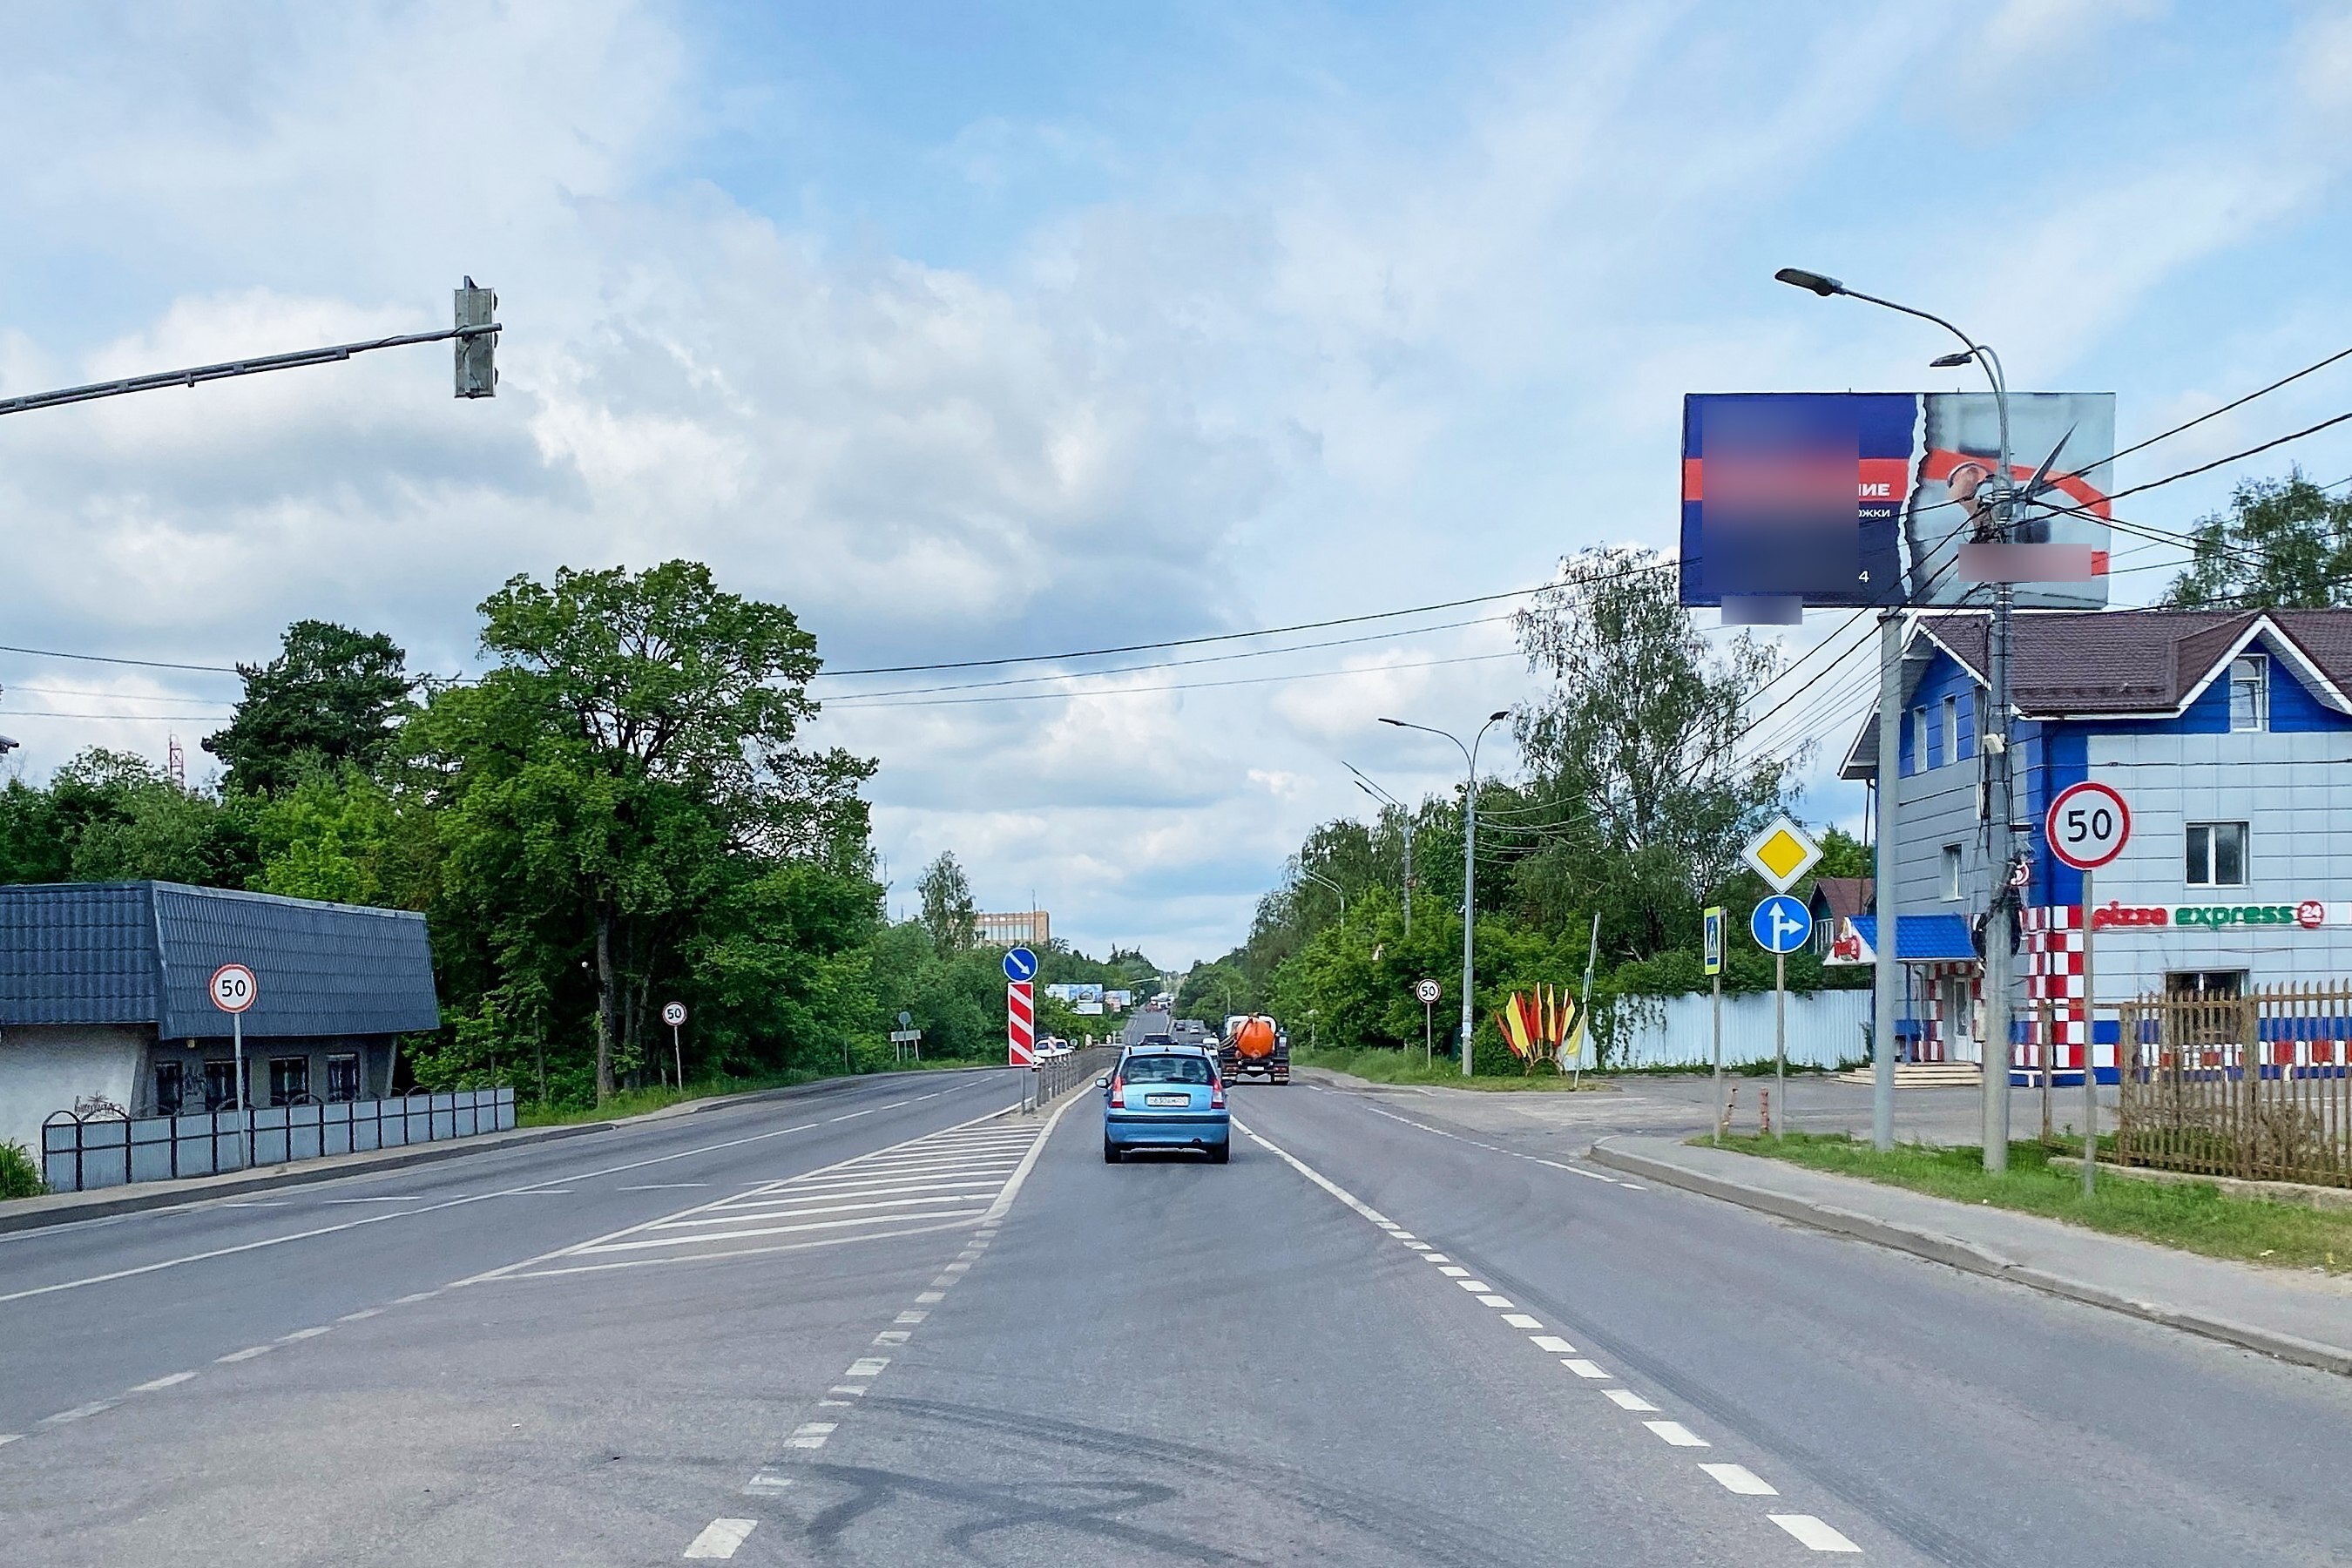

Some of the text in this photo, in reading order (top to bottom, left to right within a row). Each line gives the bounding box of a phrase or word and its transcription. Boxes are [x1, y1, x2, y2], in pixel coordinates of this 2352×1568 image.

[2068, 808, 2112, 841] 50
[2175, 906, 2295, 929] express
[222, 979, 247, 997] 50
[1422, 986, 1436, 997] 50
[667, 1008, 681, 1019] 50
